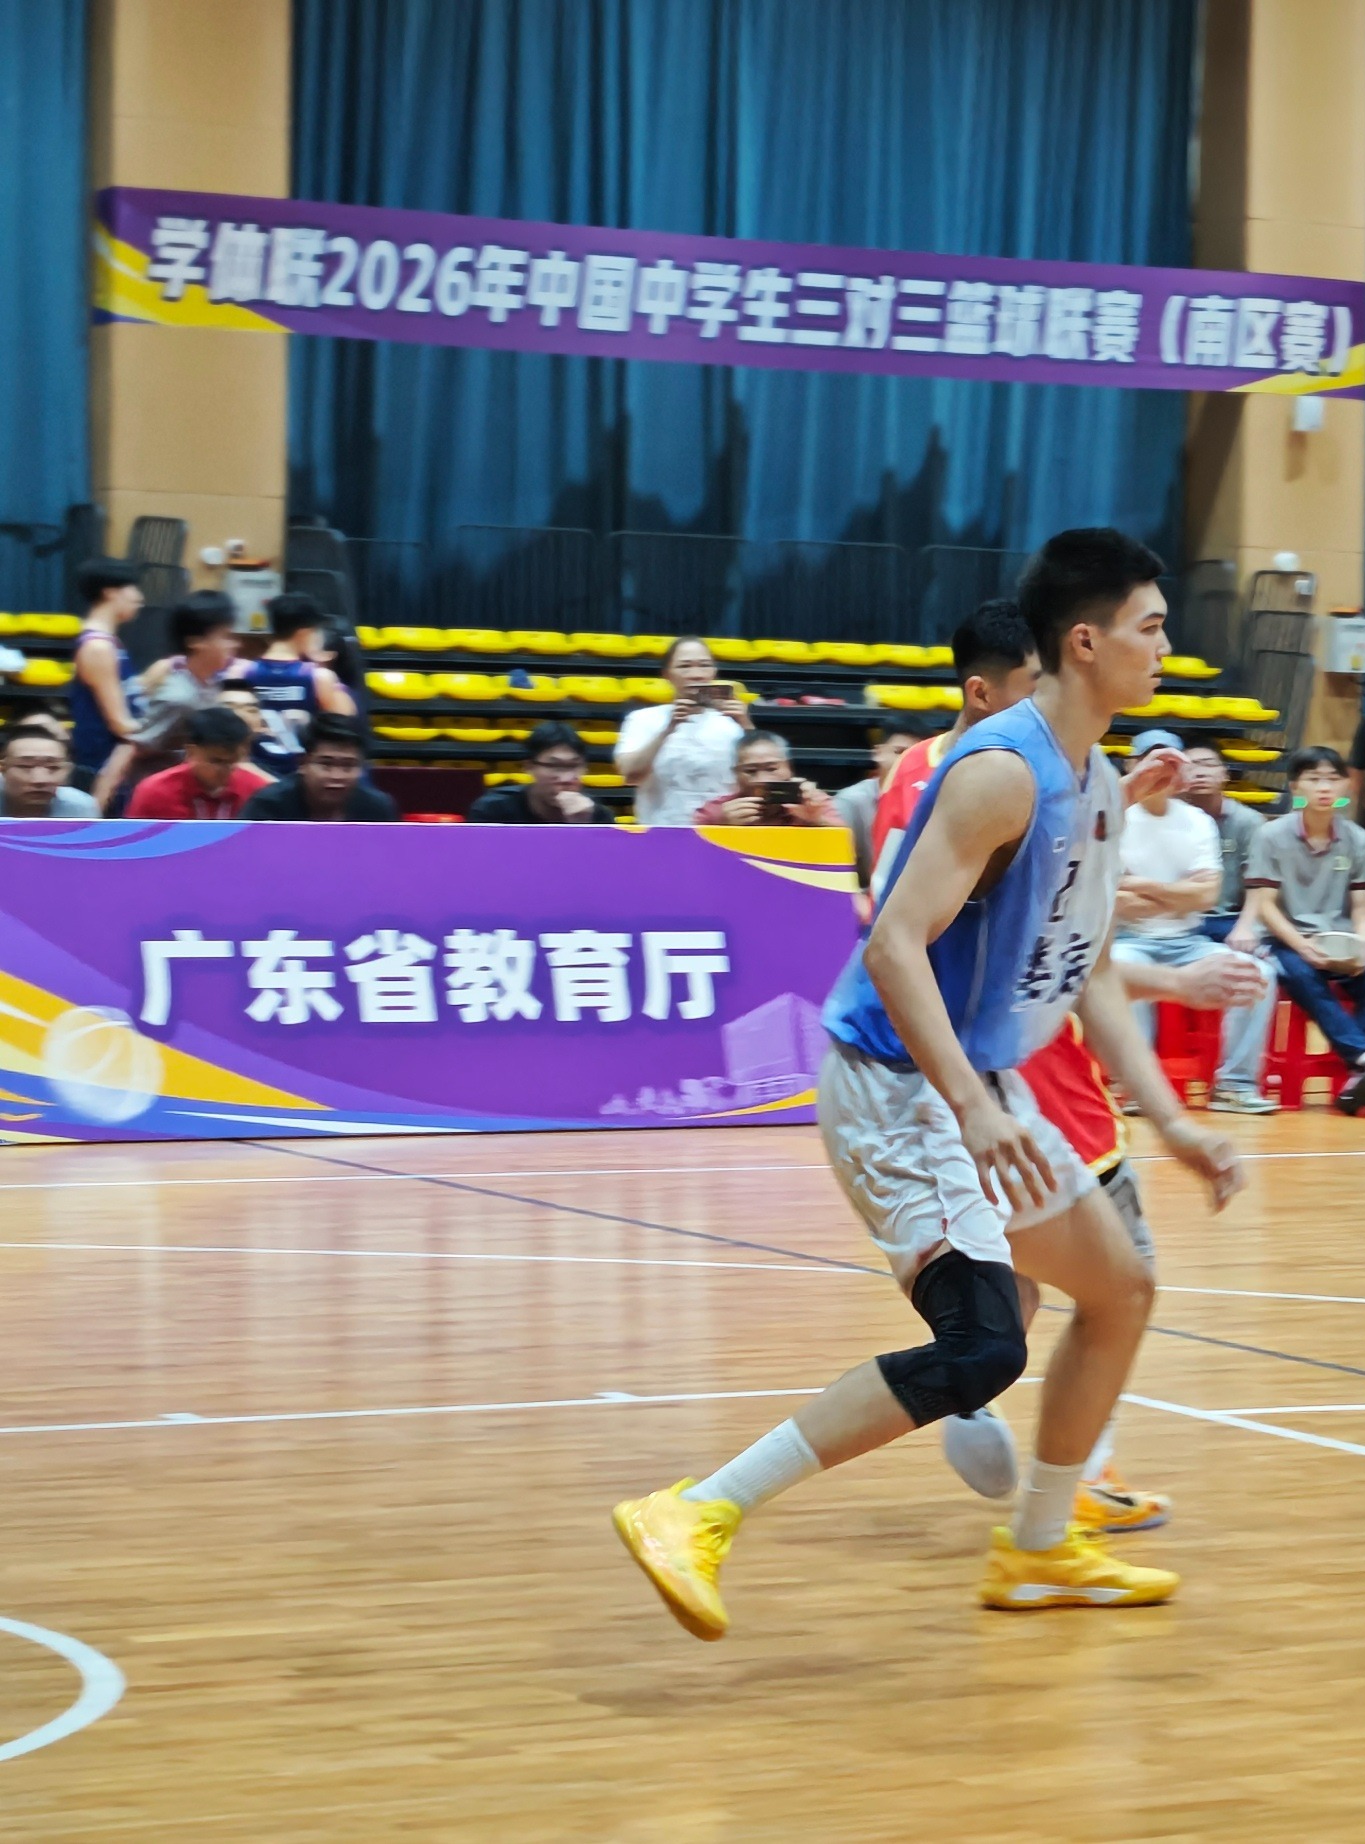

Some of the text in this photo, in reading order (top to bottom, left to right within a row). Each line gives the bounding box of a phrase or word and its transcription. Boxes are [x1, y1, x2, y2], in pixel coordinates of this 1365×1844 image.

[140, 929, 731, 1027] 广东省教育厅
